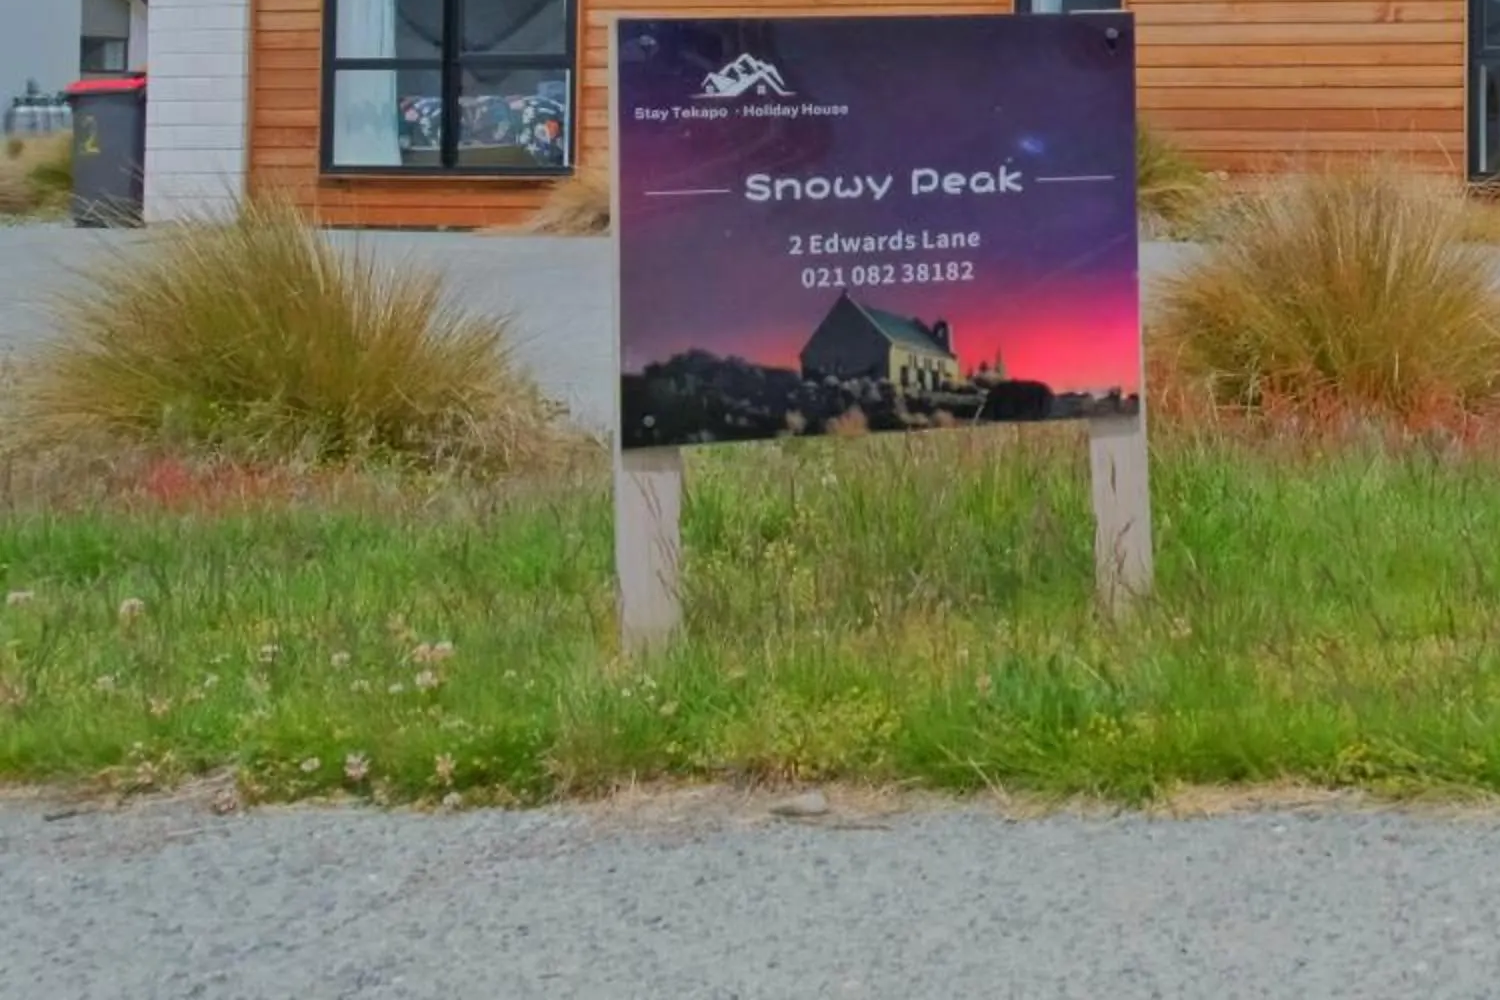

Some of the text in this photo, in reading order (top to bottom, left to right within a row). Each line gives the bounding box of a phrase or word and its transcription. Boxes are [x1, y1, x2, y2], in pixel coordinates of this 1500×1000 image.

[634, 103, 849, 121] Stay Tekapo Holiday House
[744, 165, 1023, 201] Snowy Peak
[788, 229, 981, 255] 2 Edwards Lane
[801, 261, 975, 288] 021 082 38182
